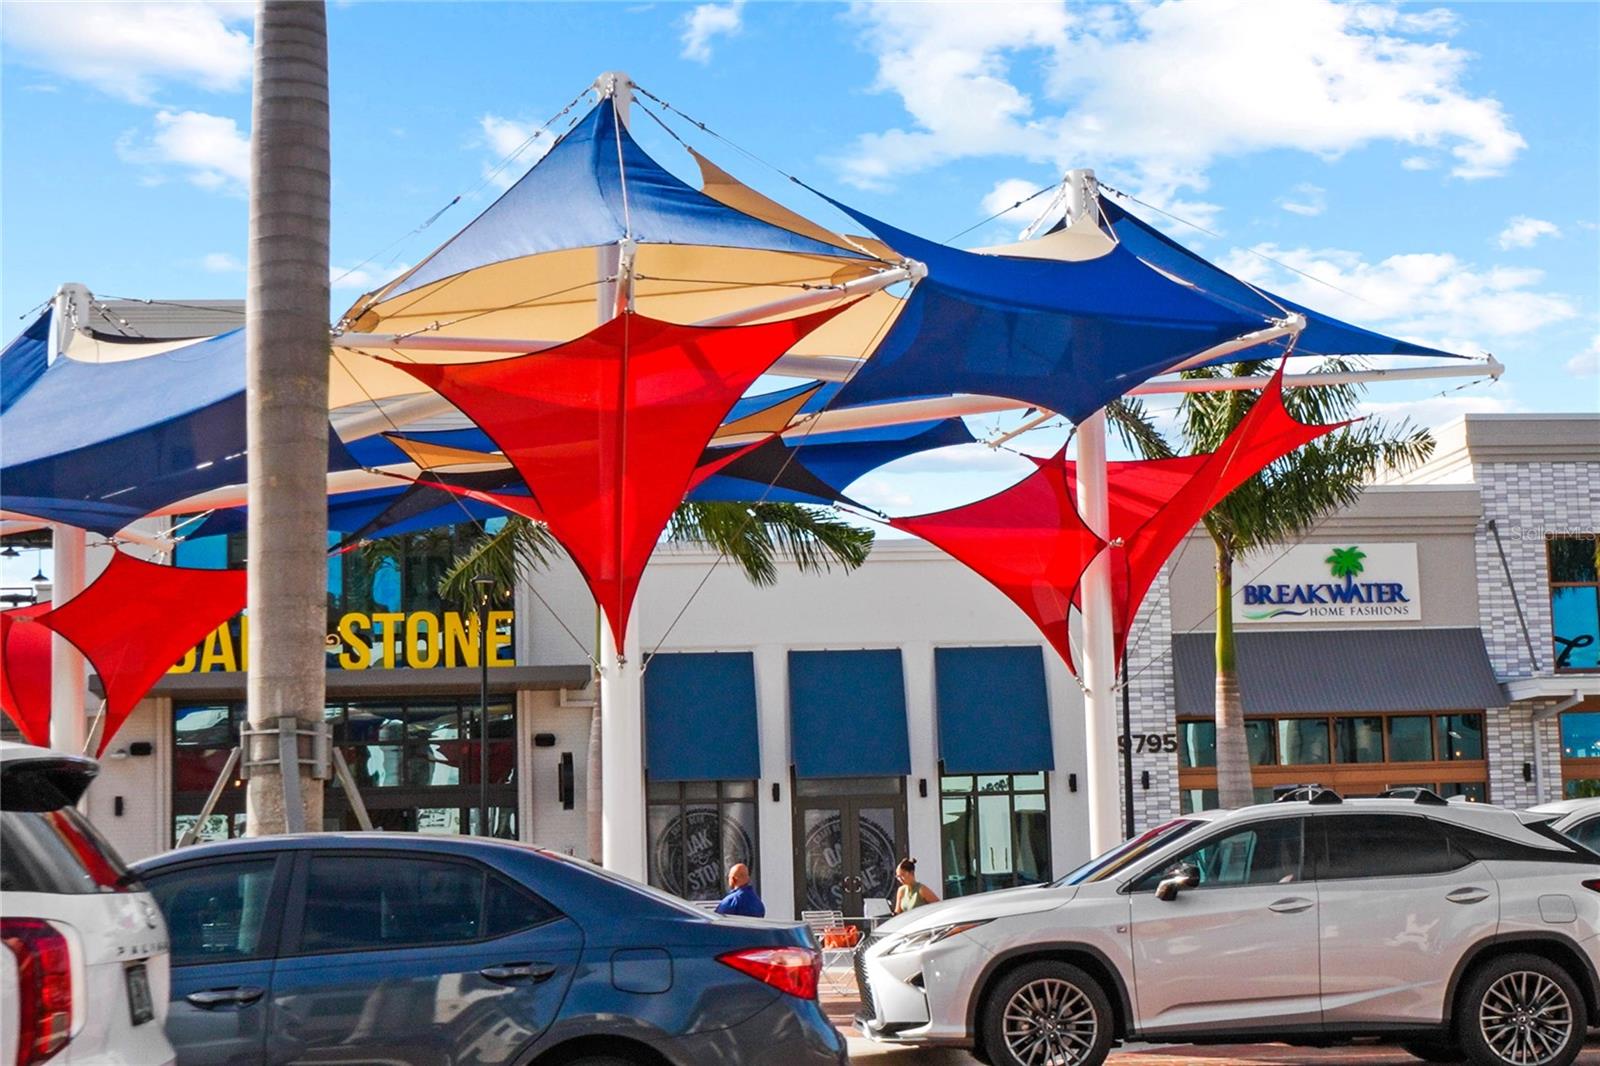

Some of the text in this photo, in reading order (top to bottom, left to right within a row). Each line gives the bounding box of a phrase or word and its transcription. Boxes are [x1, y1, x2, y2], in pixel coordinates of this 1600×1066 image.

[1243, 582, 1411, 606] BREAKWATER
[1309, 605, 1409, 617] HOME FASHIONS
[338, 610, 516, 670] STONE
